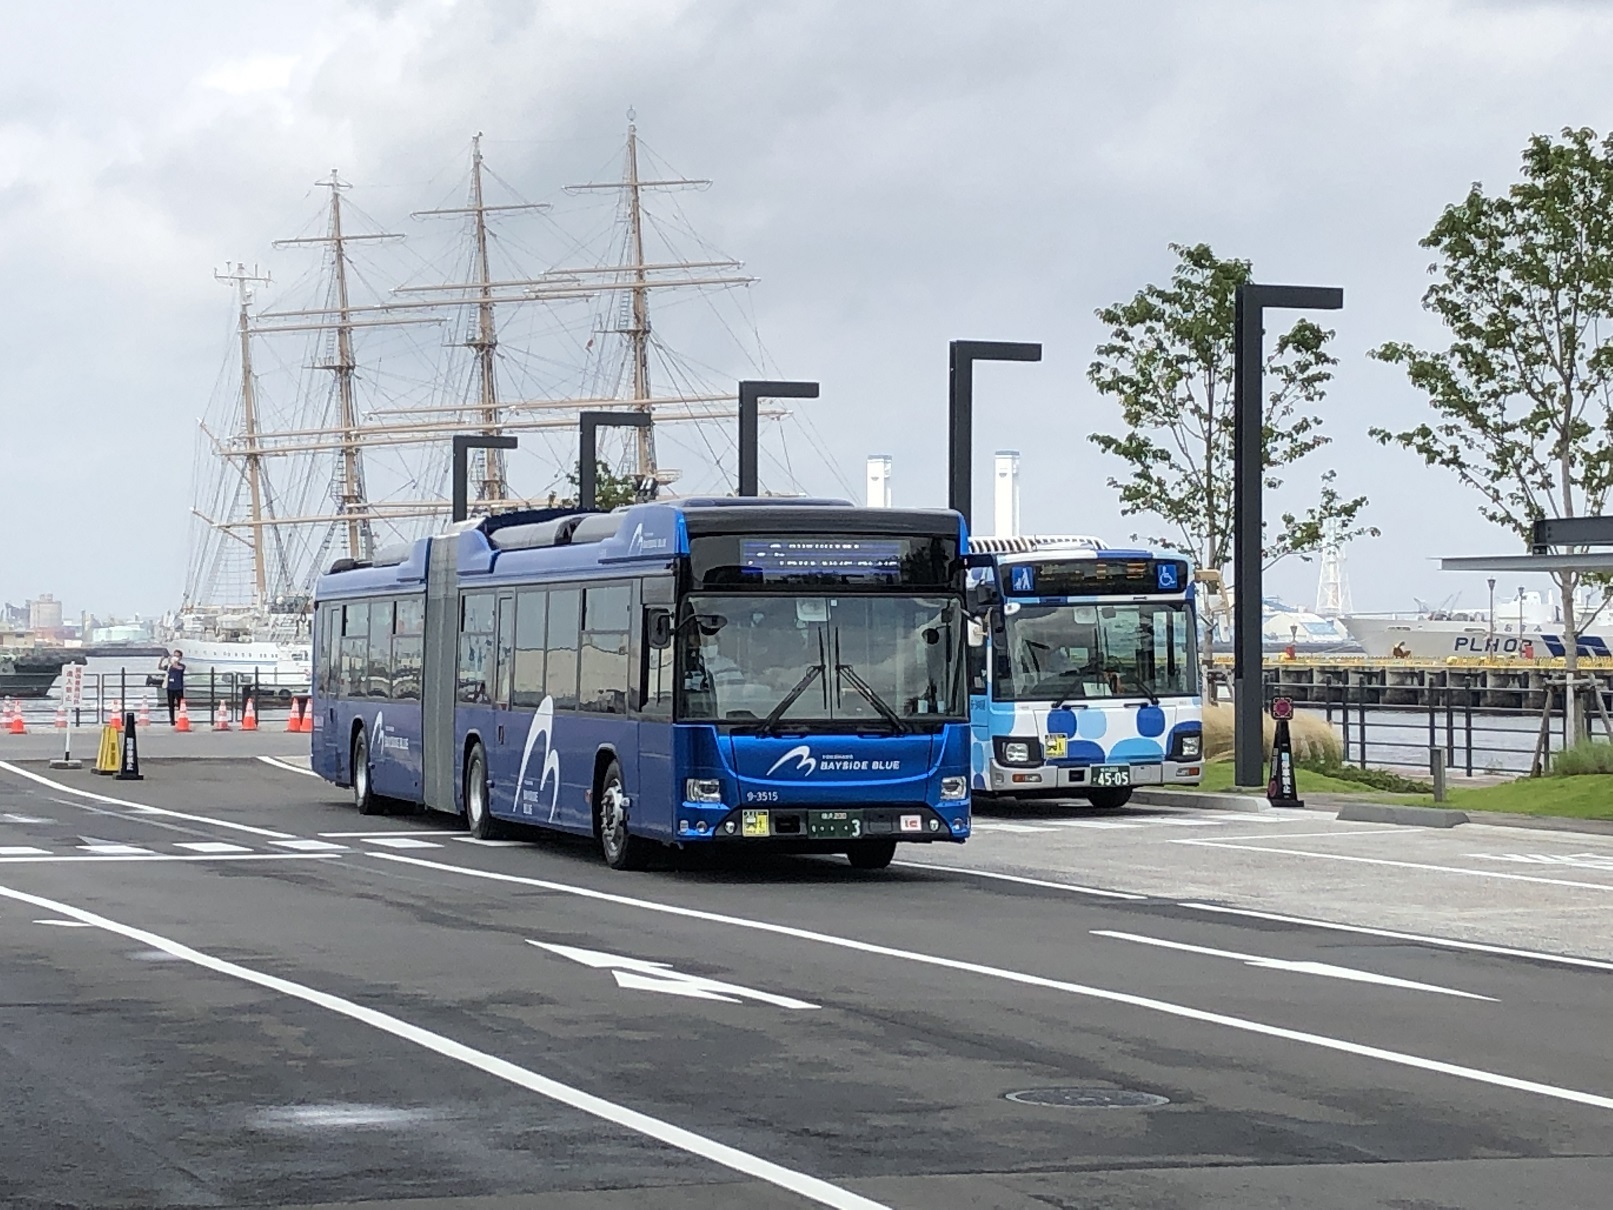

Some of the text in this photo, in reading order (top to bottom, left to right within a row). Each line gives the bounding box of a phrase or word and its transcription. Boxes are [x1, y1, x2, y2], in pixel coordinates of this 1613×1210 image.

[820, 761, 900, 770] BAYSIDE BLUE
[747, 792, 778, 801] 9-3515
